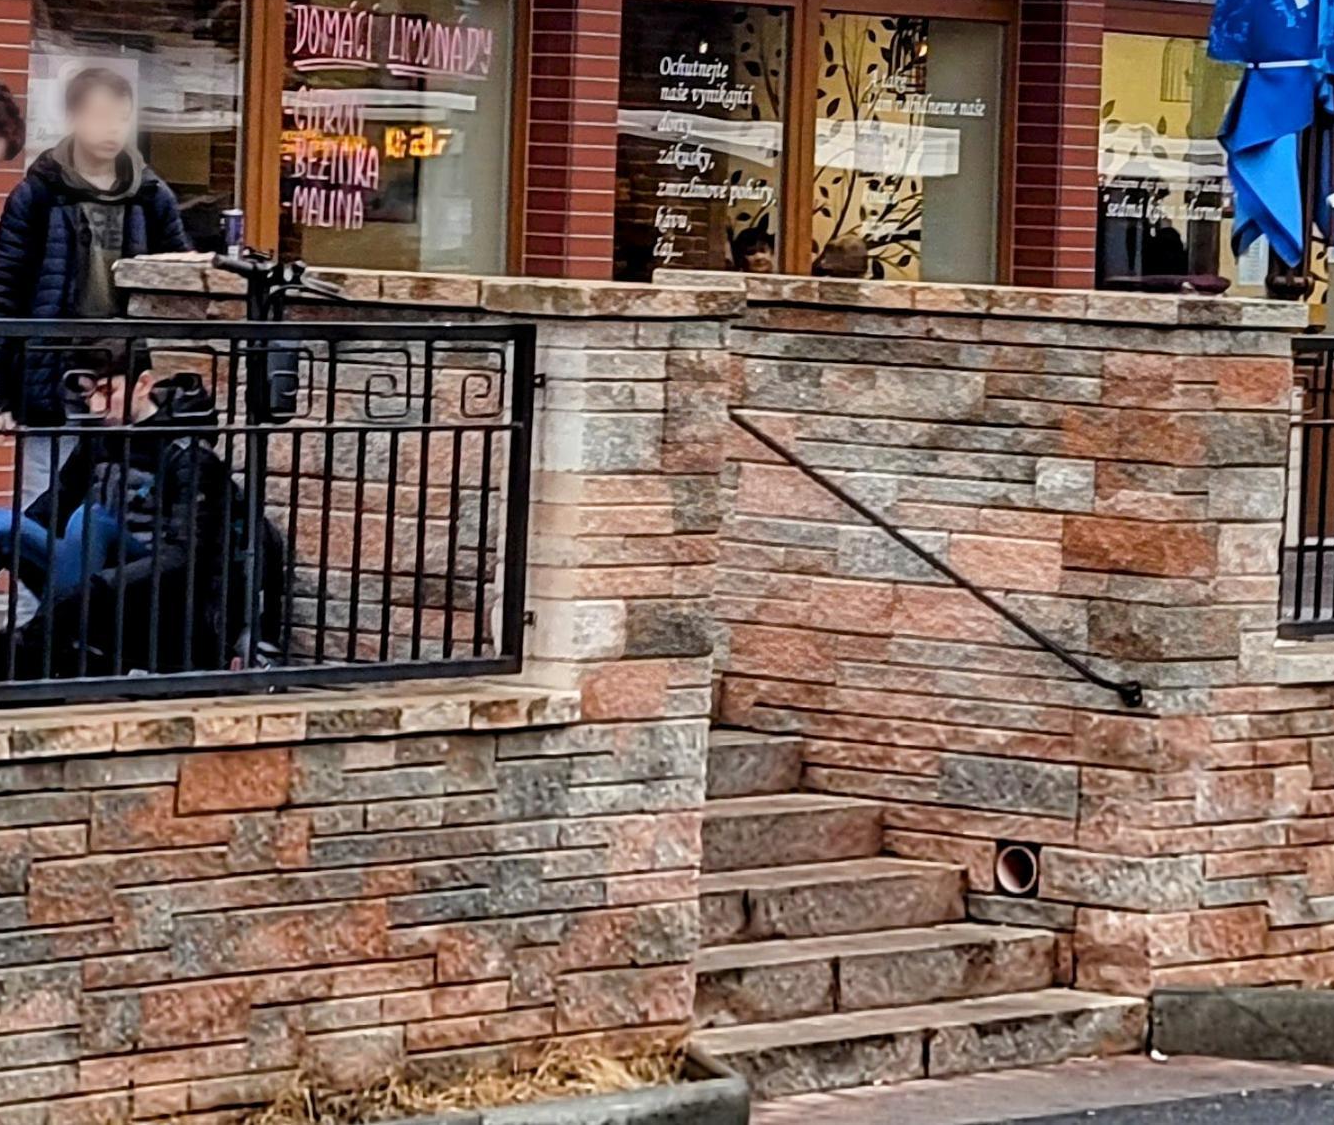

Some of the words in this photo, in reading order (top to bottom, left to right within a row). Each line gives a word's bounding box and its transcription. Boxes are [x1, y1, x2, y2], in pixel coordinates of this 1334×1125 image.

[292, 0, 380, 61] DOMÁCÍ
[660, 53, 730, 85] Ochutnejte
[660, 81, 690, 102] naše
